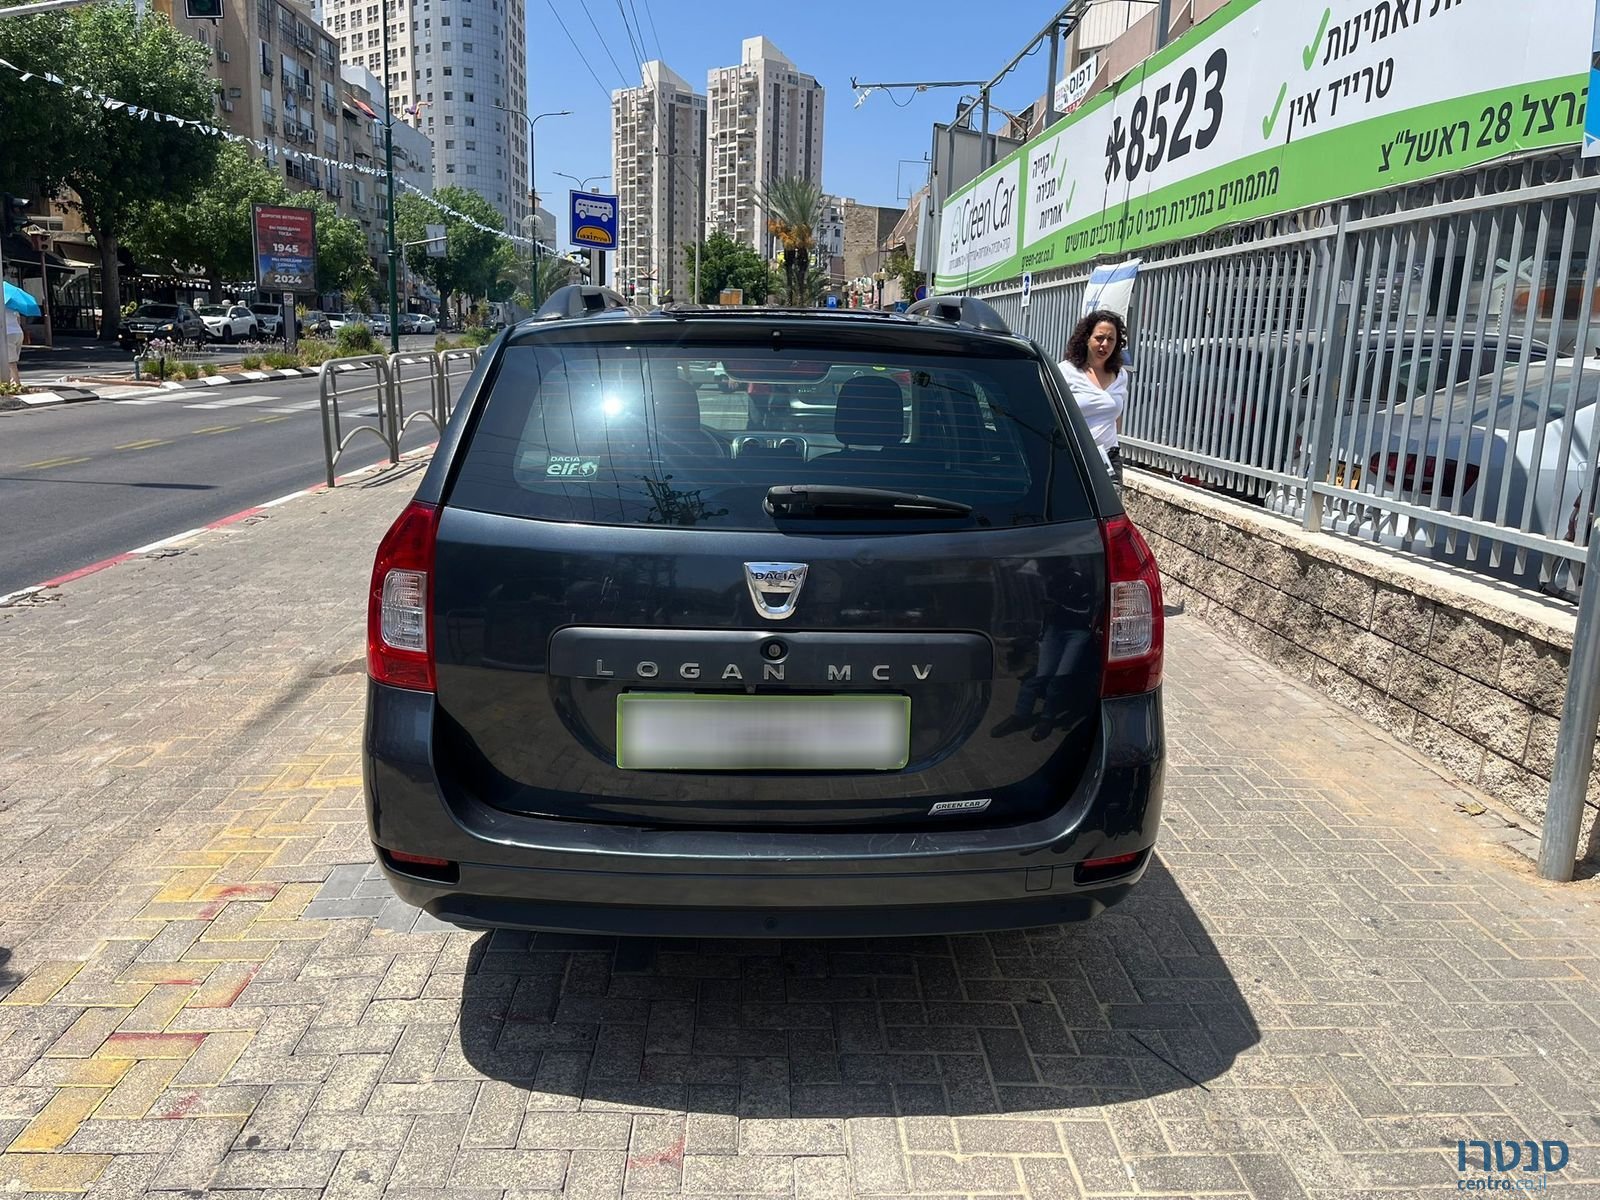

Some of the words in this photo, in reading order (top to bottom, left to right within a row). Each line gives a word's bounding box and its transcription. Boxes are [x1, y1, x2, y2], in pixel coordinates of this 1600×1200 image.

[1070, 63, 1091, 94] דפוס
[1329, 57, 1394, 116] טרייד
[1286, 88, 1321, 144] אין
[1477, 102, 1513, 148] 28
[1032, 153, 1050, 178] קנייה
[1036, 178, 1056, 204] מכירה
[1218, 166, 1279, 210] מתמחים
[962, 199, 990, 245] Green
[993, 177, 1016, 231] Car
[1039, 203, 1063, 230] אחריות
[1146, 205, 1167, 232] רכבי
[1169, 189, 1214, 225] במכירת
[1136, 209, 1143, 235] 0
[273, 243, 299, 253] 1945
[1065, 231, 1088, 253] חדשים
[1021, 243, 1055, 271] green-car.co.il
[274, 275, 302, 284] 2024
[547, 463, 580, 475] elf
[755, 572, 796, 581] DACIA
[597, 659, 785, 681] LOGAN
[828, 664, 932, 681] MCV
